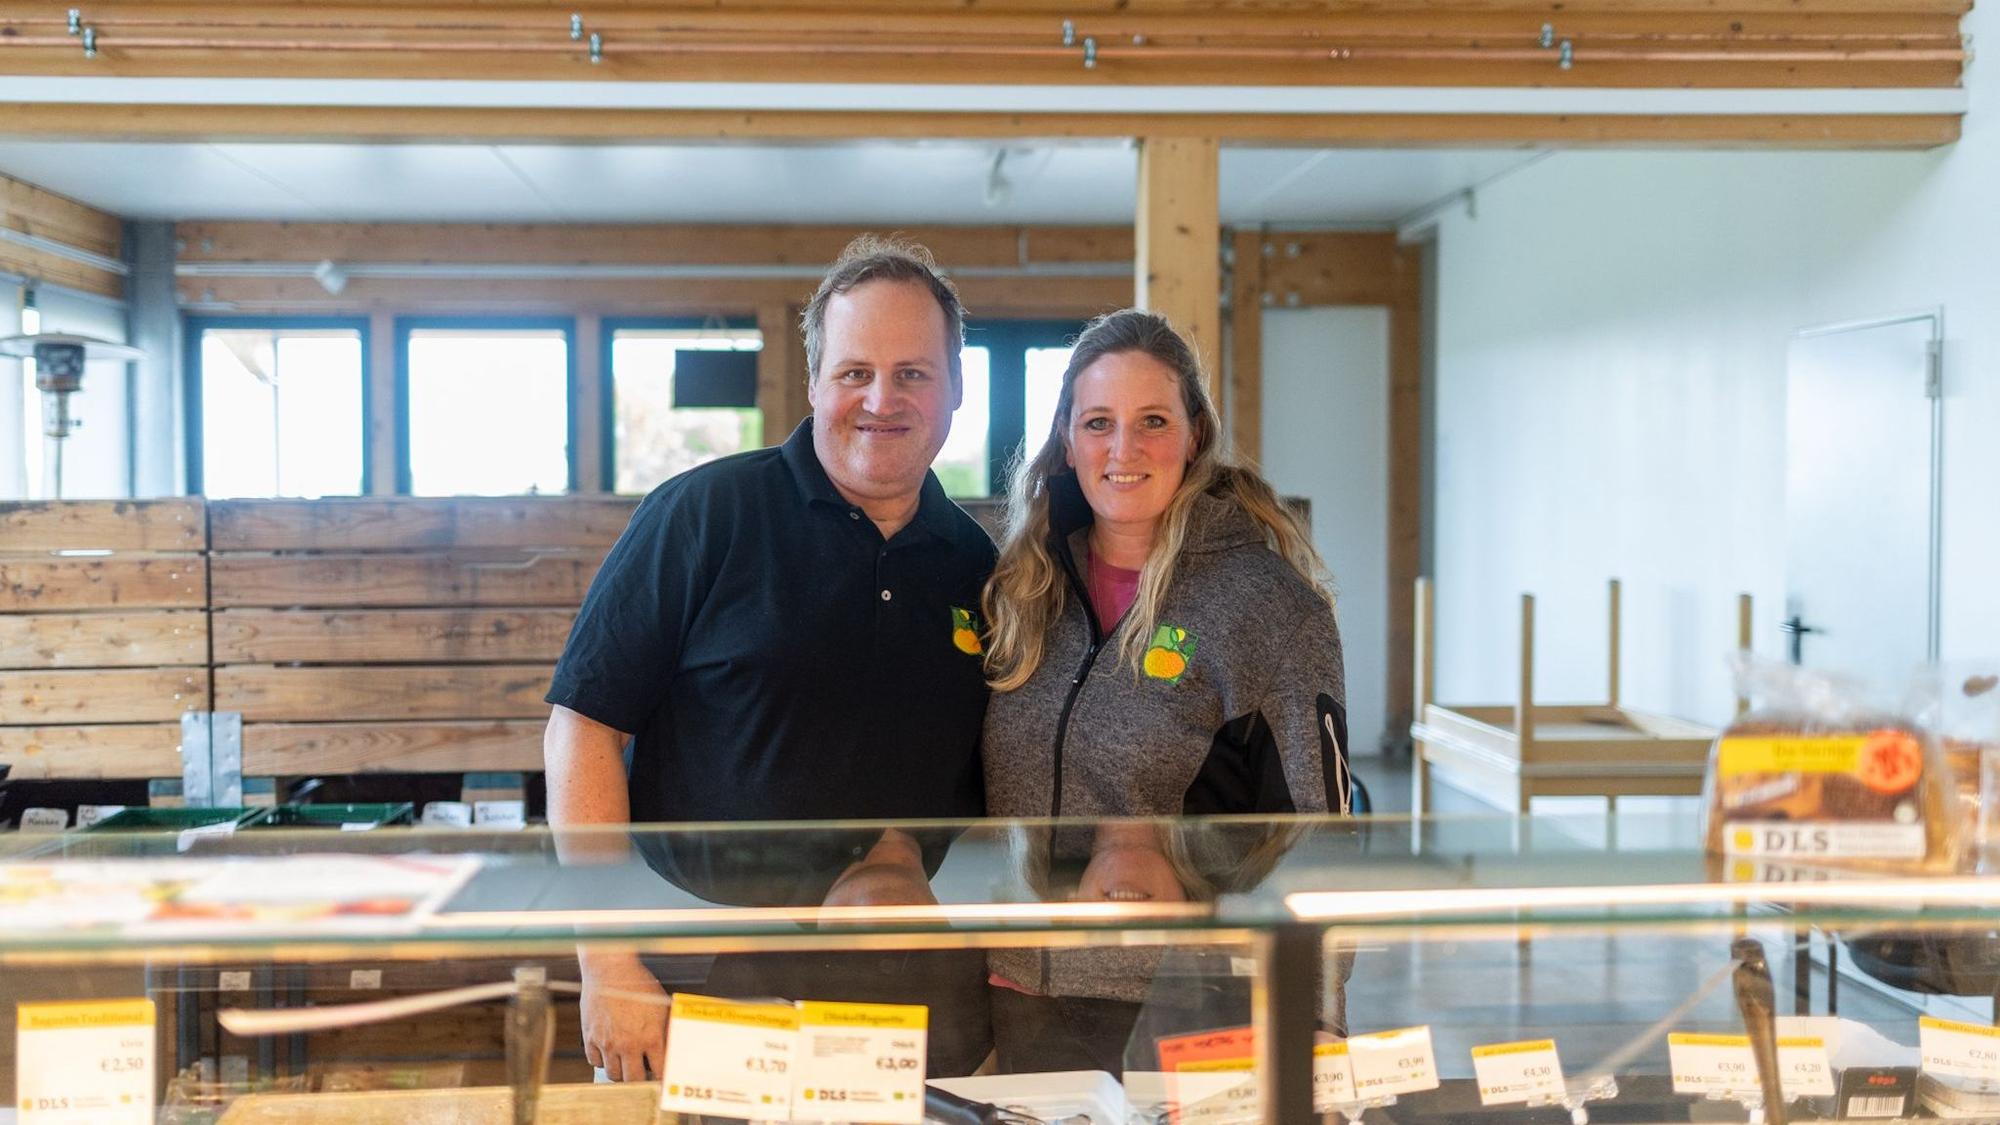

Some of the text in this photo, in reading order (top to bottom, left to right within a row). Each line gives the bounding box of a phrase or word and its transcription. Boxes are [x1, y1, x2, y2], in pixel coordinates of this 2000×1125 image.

[1765, 830, 1829, 852] DLS
[683, 1086, 713, 1100] DLS
[819, 1088, 847, 1102] DLS
[1491, 1085, 1509, 1094] DLS
[38, 1097, 69, 1110] DLS
